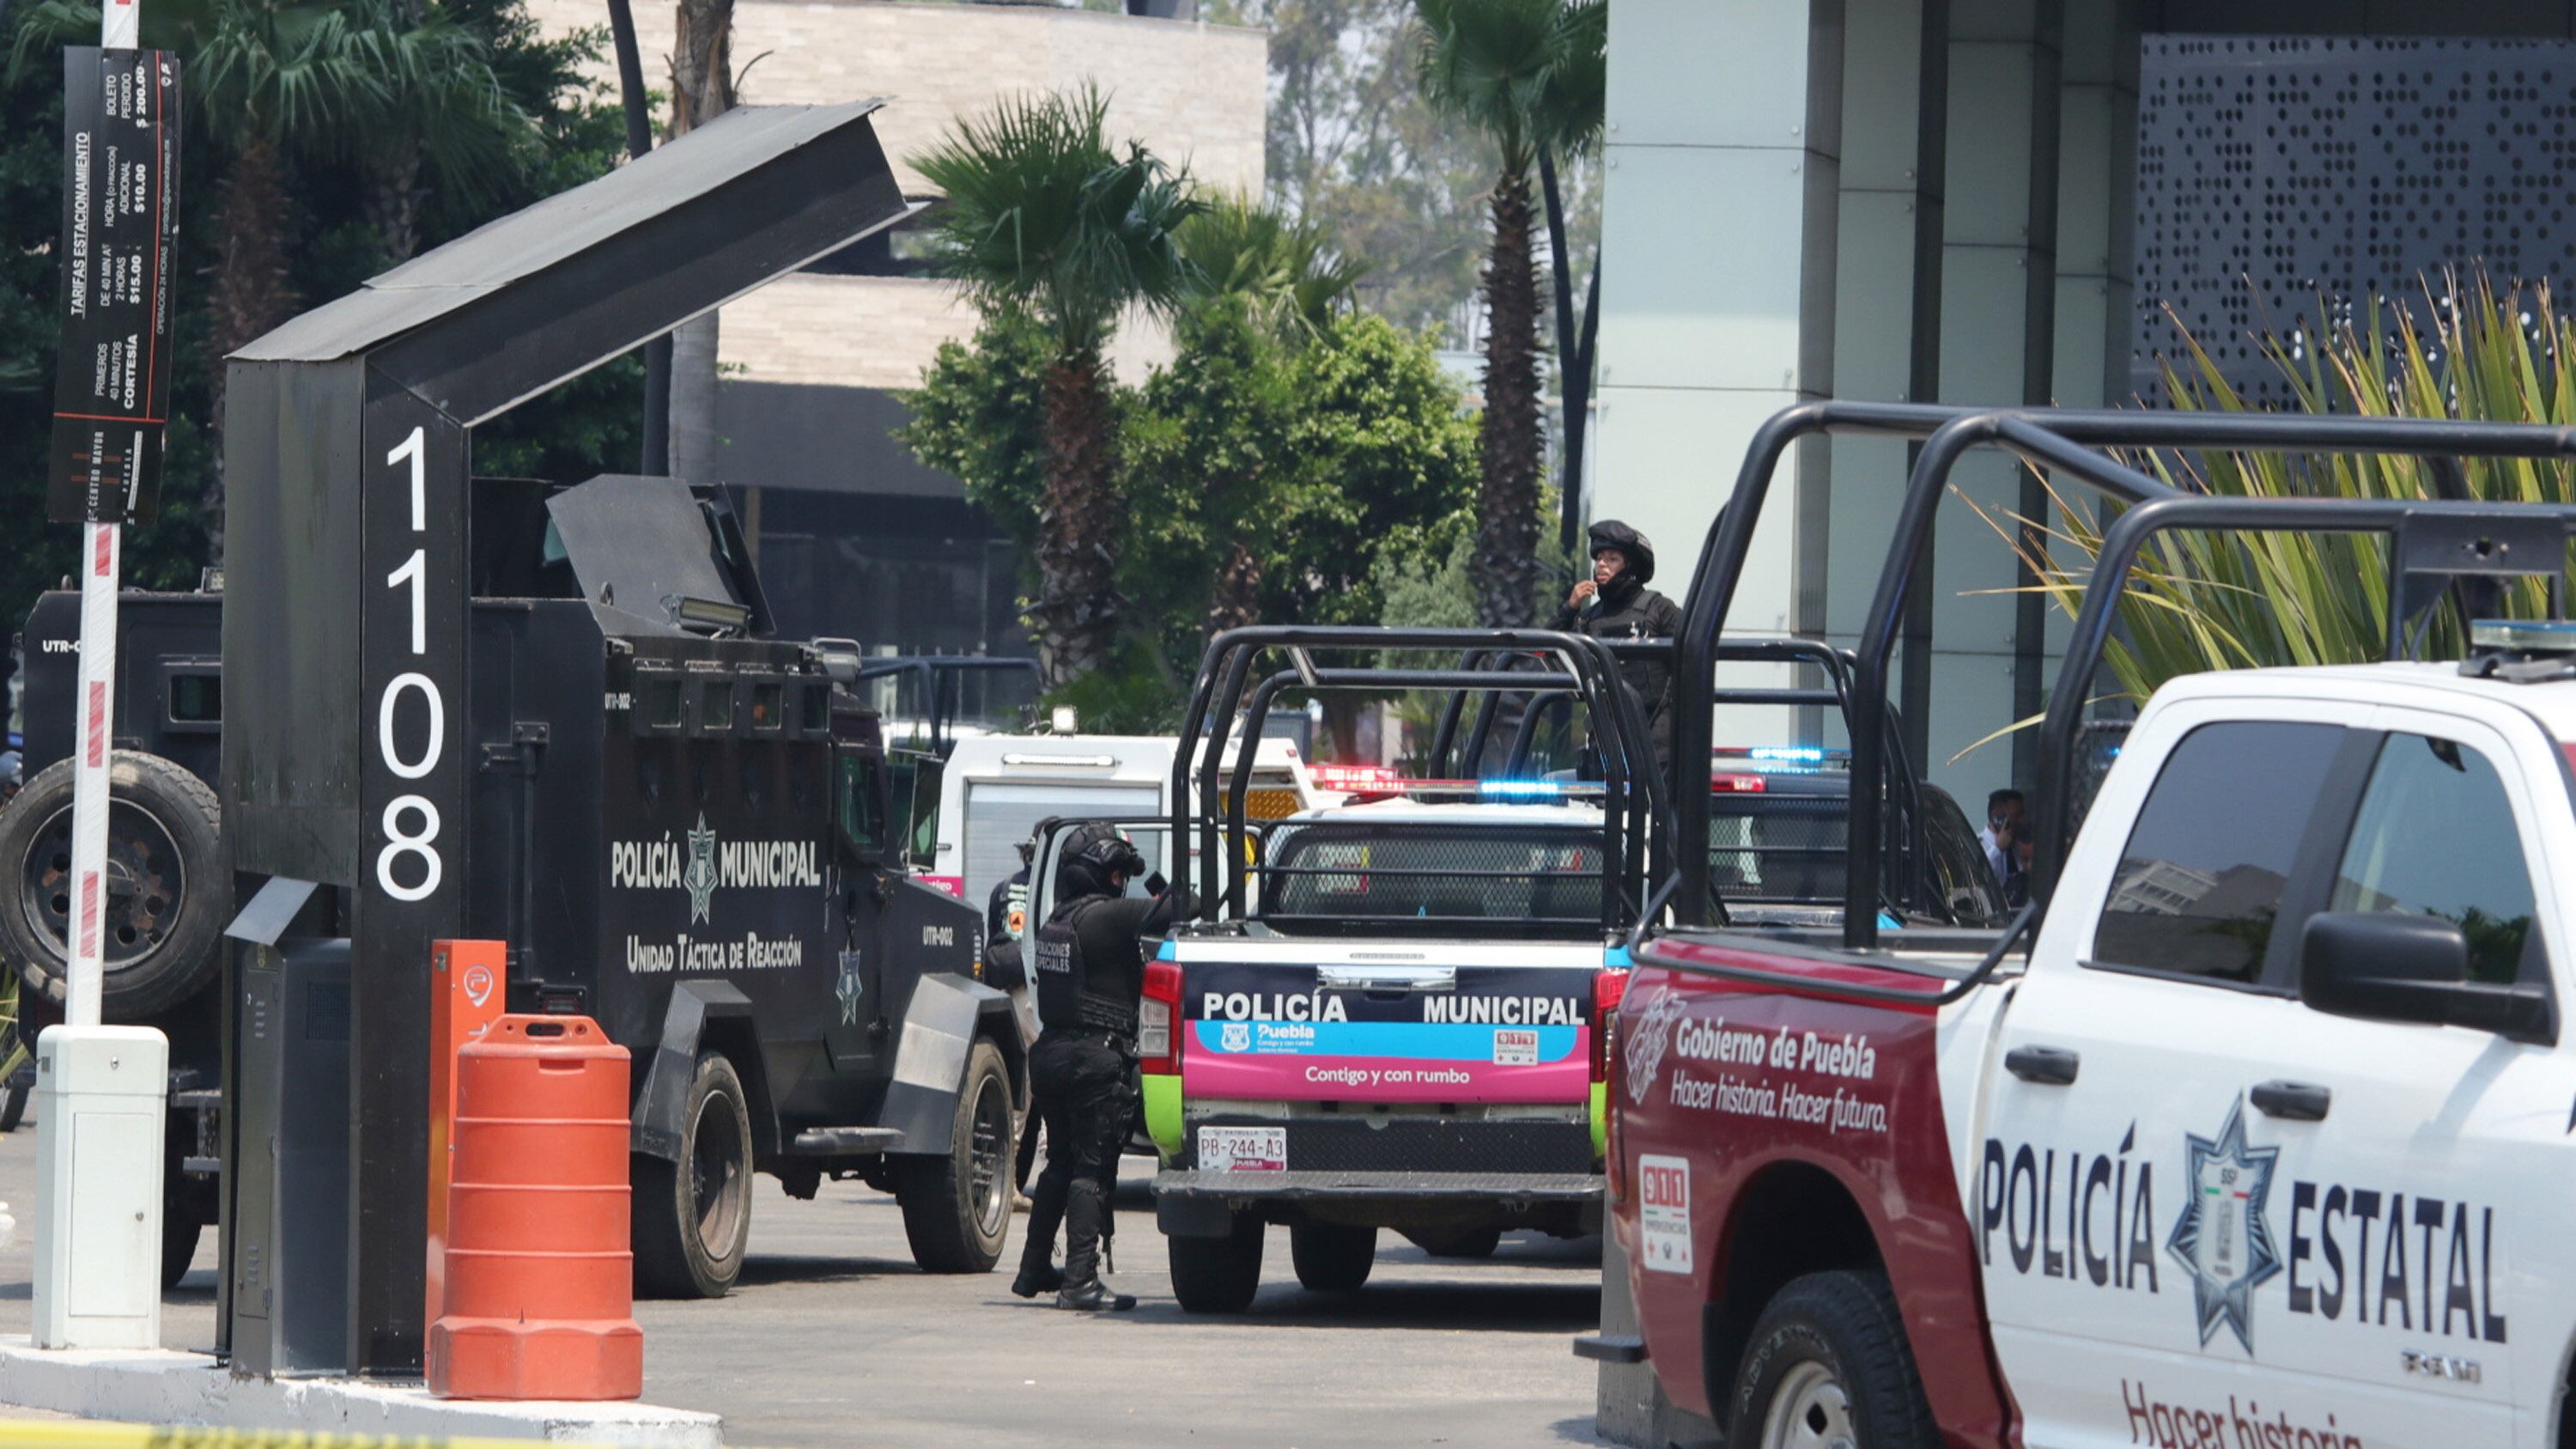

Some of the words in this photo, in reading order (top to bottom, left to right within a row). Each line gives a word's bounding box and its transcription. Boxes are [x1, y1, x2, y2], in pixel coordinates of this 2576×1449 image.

[106, 75, 117, 116] BOLETO
[121, 73, 131, 119] PERDIDO
[136, 65, 146, 115] 200.00
[74, 132, 89, 257] ESTACIONAMIENTO
[119, 161, 131, 215] ADICIONAL
[135, 163, 146, 213] $10.00
[105, 198, 115, 228] HORA
[101, 257, 112, 277] MIN
[115, 257, 126, 293] HORAS
[160, 246, 169, 271] HORAS
[71, 259, 86, 316] TARIFAS
[100, 291, 111, 307] DE
[101, 277, 112, 291] 40
[130, 254, 143, 305] $15.00
[160, 276, 167, 285] 24
[156, 287, 167, 335] OPERACIÓN
[94, 343, 108, 397] PRIMEROS
[110, 341, 122, 387] MINUTOS
[124, 334, 138, 410] CORTESÍA
[110, 387, 119, 401] 40
[92, 431, 104, 465] MAYOR
[88, 469, 100, 507] CENTRO
[611, 830, 681, 888] POLICÍA
[720, 840, 822, 888] MUNICIPAL
[627, 935, 674, 973] UNIDAD
[677, 934, 726, 971] TÁCTICA
[729, 941, 744, 970] DE
[747, 931, 802, 969] REACCIÓN
[922, 925, 954, 947] UTR-002
[1204, 989, 1348, 1022] POLICÍA
[1423, 995, 1586, 1026] MUNICIPAL
[1257, 1023, 1315, 1039] Puebla
[1498, 1032, 1534, 1044] 911
[1676, 1016, 1766, 1066] Gobierno
[1770, 1026, 1798, 1070] de
[1800, 1032, 1876, 1080] Puebla
[1305, 1066, 1367, 1087] Contigo
[1372, 1071, 1381, 1086] y
[1385, 1072, 1413, 1083] con
[1416, 1067, 1470, 1084] rumbo
[1670, 1069, 1716, 1109] Hacer
[1716, 1073, 1776, 1117] historia.
[1779, 1082, 1831, 1124] Hacer
[1830, 1087, 1887, 1135] futuro.
[1201, 1138, 1283, 1158] PB-244-A3
[1646, 1170, 1683, 1202] 911
[1983, 1118, 2159, 1293] POLICÍA
[2288, 1180, 2508, 1344] ESTATAL
[2121, 1379, 2225, 1449] Hacer
